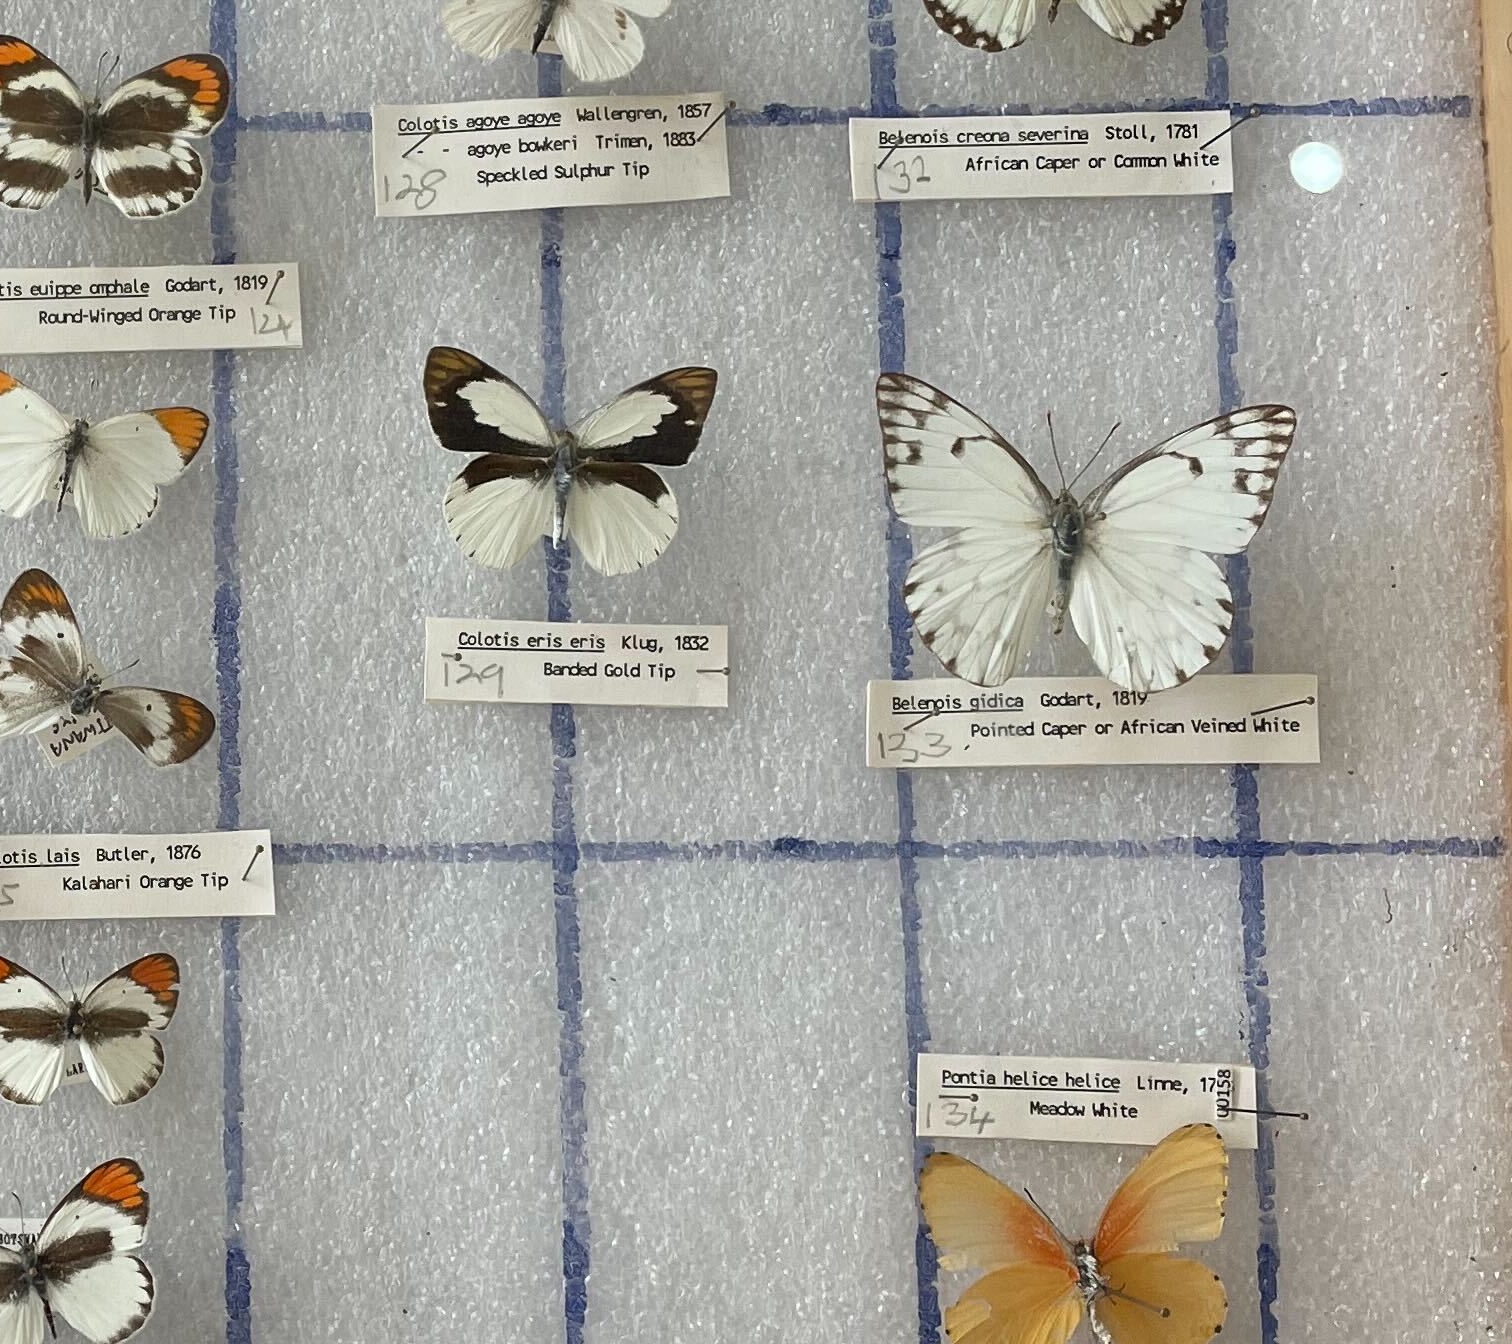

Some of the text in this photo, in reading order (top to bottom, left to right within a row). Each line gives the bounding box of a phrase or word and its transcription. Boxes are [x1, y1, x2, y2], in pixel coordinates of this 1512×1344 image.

[965, 153, 1219, 171] African Caper or Common White
[478, 163, 649, 186] Speckled Sulphur Tip
[39, 307, 236, 325] Round-Winged Orange Tip
[458, 632, 709, 652] Colotis eris eris Klug, 1832
[544, 663, 675, 681] Banded Gold Tip
[971, 718, 1300, 739] Pointed Caper or African Veined White
[47, 848, 80, 863] lais
[96, 847, 155, 864] Butler,
[167, 845, 201, 860] 1876
[63, 873, 229, 891] Kalahari Orange Tip
[1030, 1101, 1138, 1118] Meadow White
